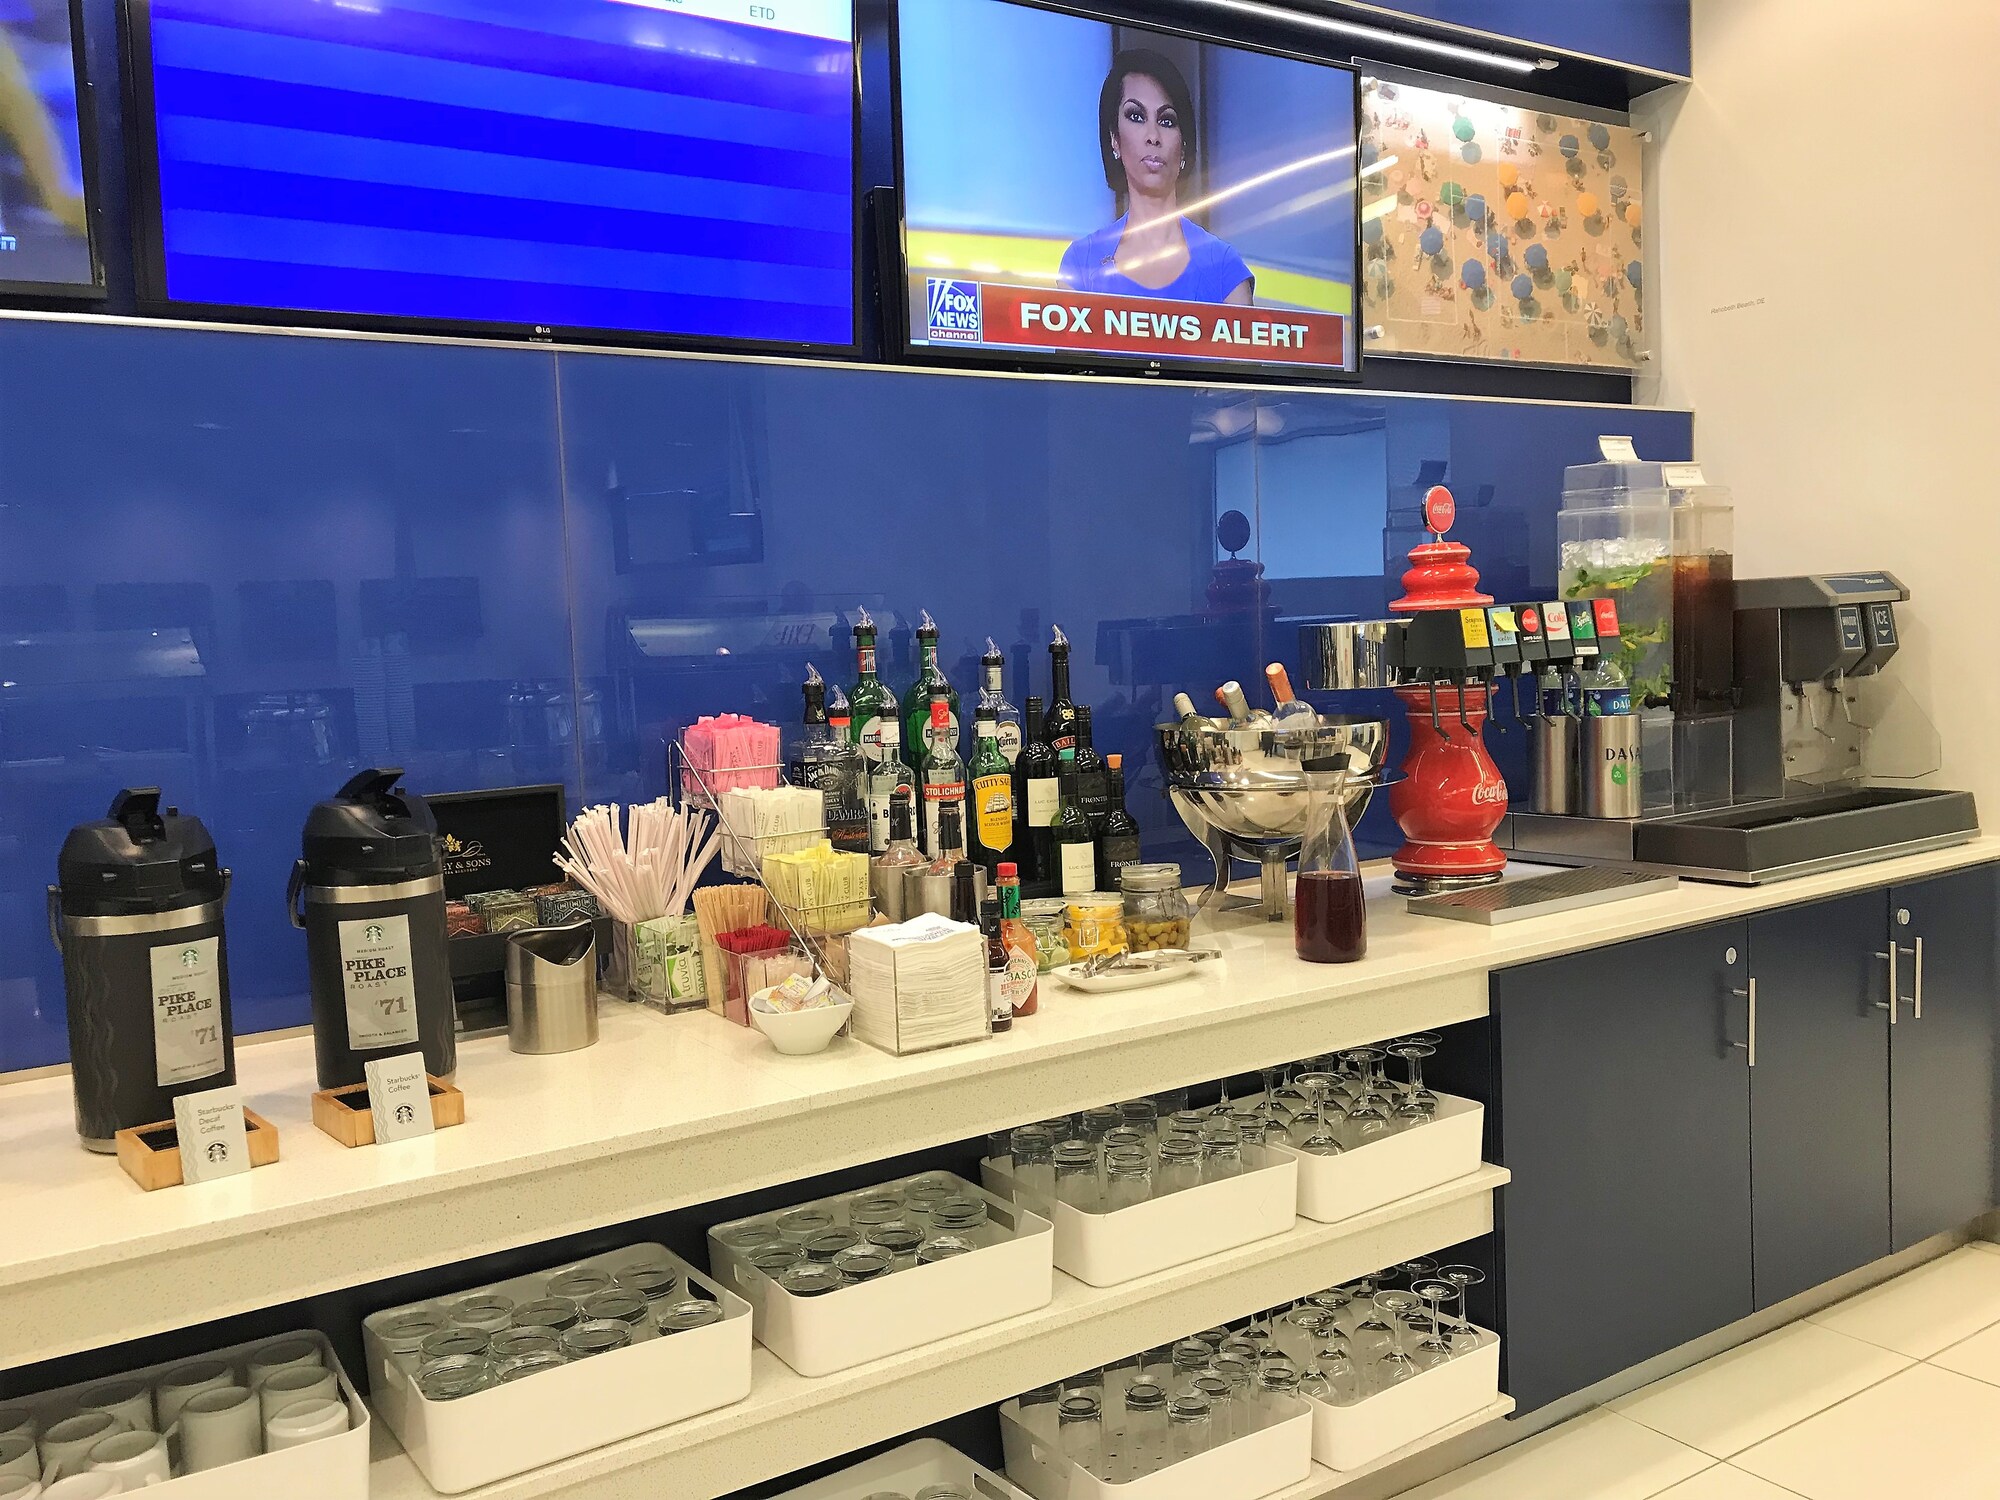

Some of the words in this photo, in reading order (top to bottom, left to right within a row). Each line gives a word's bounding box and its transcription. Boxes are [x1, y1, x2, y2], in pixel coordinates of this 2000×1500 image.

[749, 5, 776, 21] ETD
[944, 293, 977, 312] FOX
[936, 311, 979, 329] NEWS
[1020, 302, 1093, 334] FOX
[1104, 308, 1201, 342] NEWS
[1211, 318, 1309, 349] ALERT
[930, 329, 979, 341] channel
[1874, 610, 1890, 626] ICE
[975, 778, 999, 791] CUTTY
[466, 858, 491, 868] SONS
[345, 957, 385, 971] PIKE
[354, 966, 407, 983] PLACE
[350, 980, 388, 990] ROAST
[158, 991, 197, 1008] PIKE
[166, 998, 213, 1018] PLACE
[388, 1083, 412, 1094] Coffee
[198, 1115, 221, 1126] Decaf
[200, 1124, 226, 1135] Coffee
